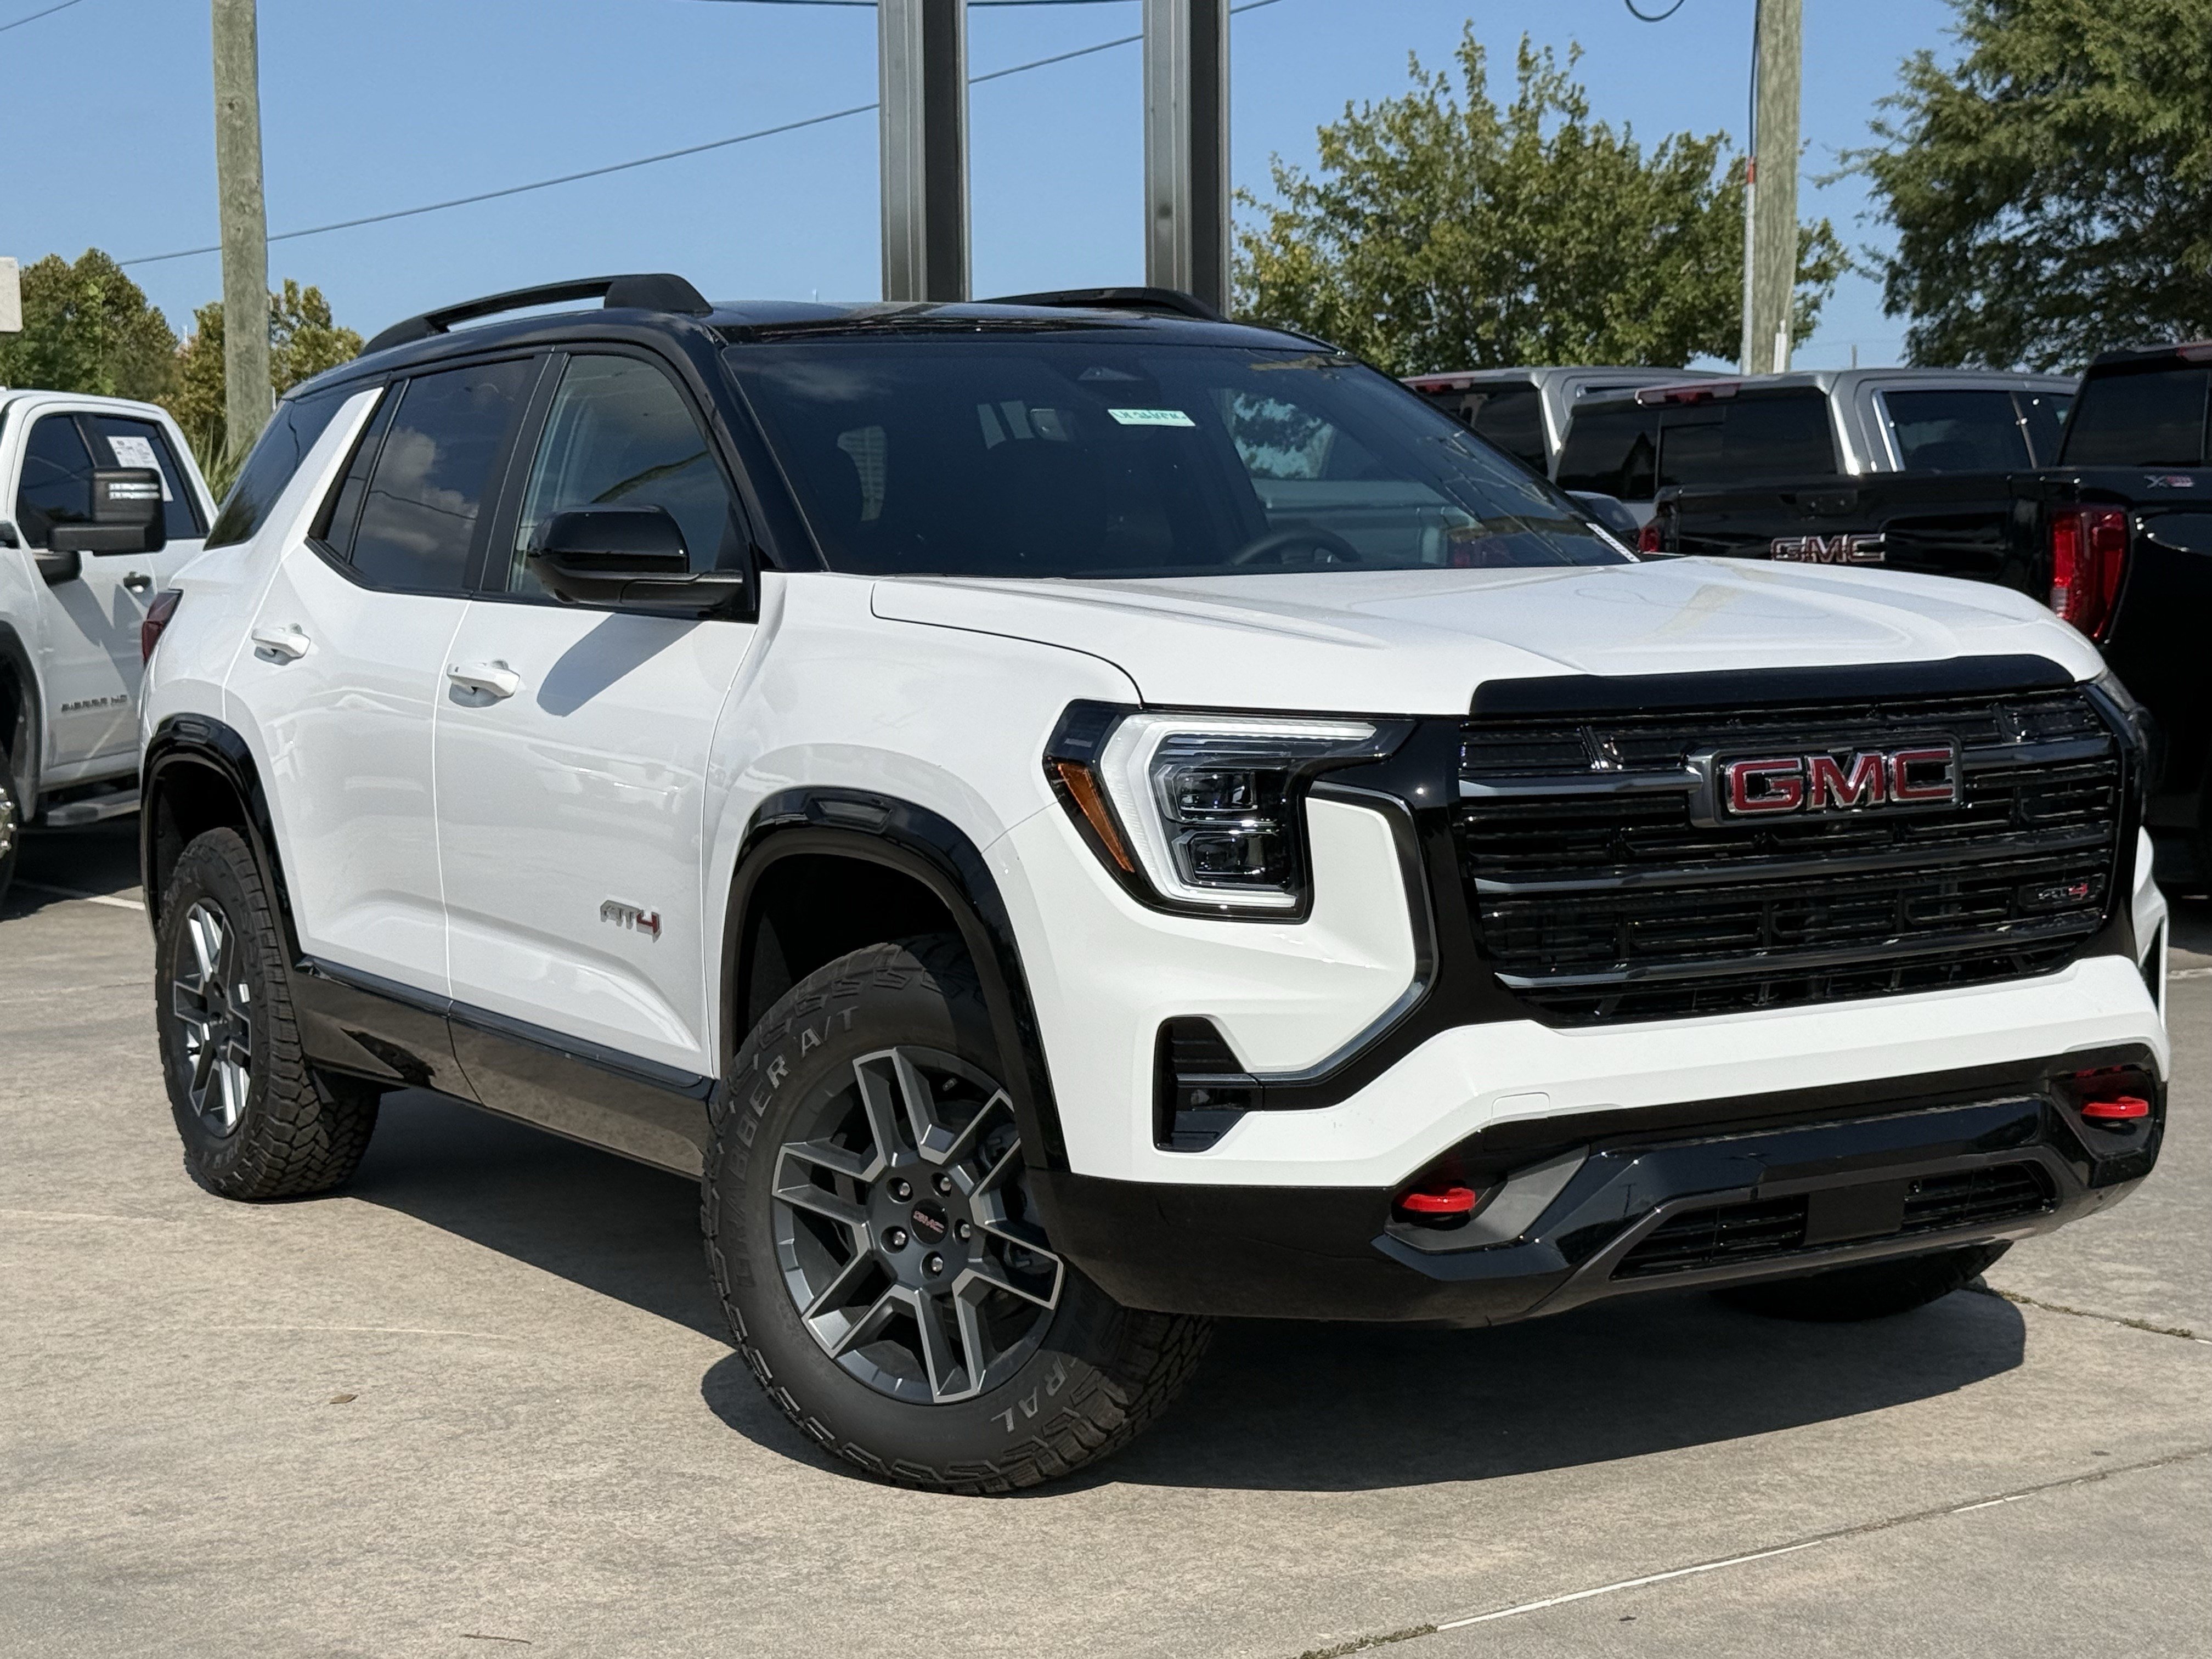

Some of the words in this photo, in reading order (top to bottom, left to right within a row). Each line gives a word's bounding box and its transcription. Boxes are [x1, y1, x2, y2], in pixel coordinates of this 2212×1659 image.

[1770, 532, 1886, 563] GMC
[1726, 747, 1957, 814] GMC
[600, 899, 662, 944] AT4
[913, 1210, 945, 1234] GMC
